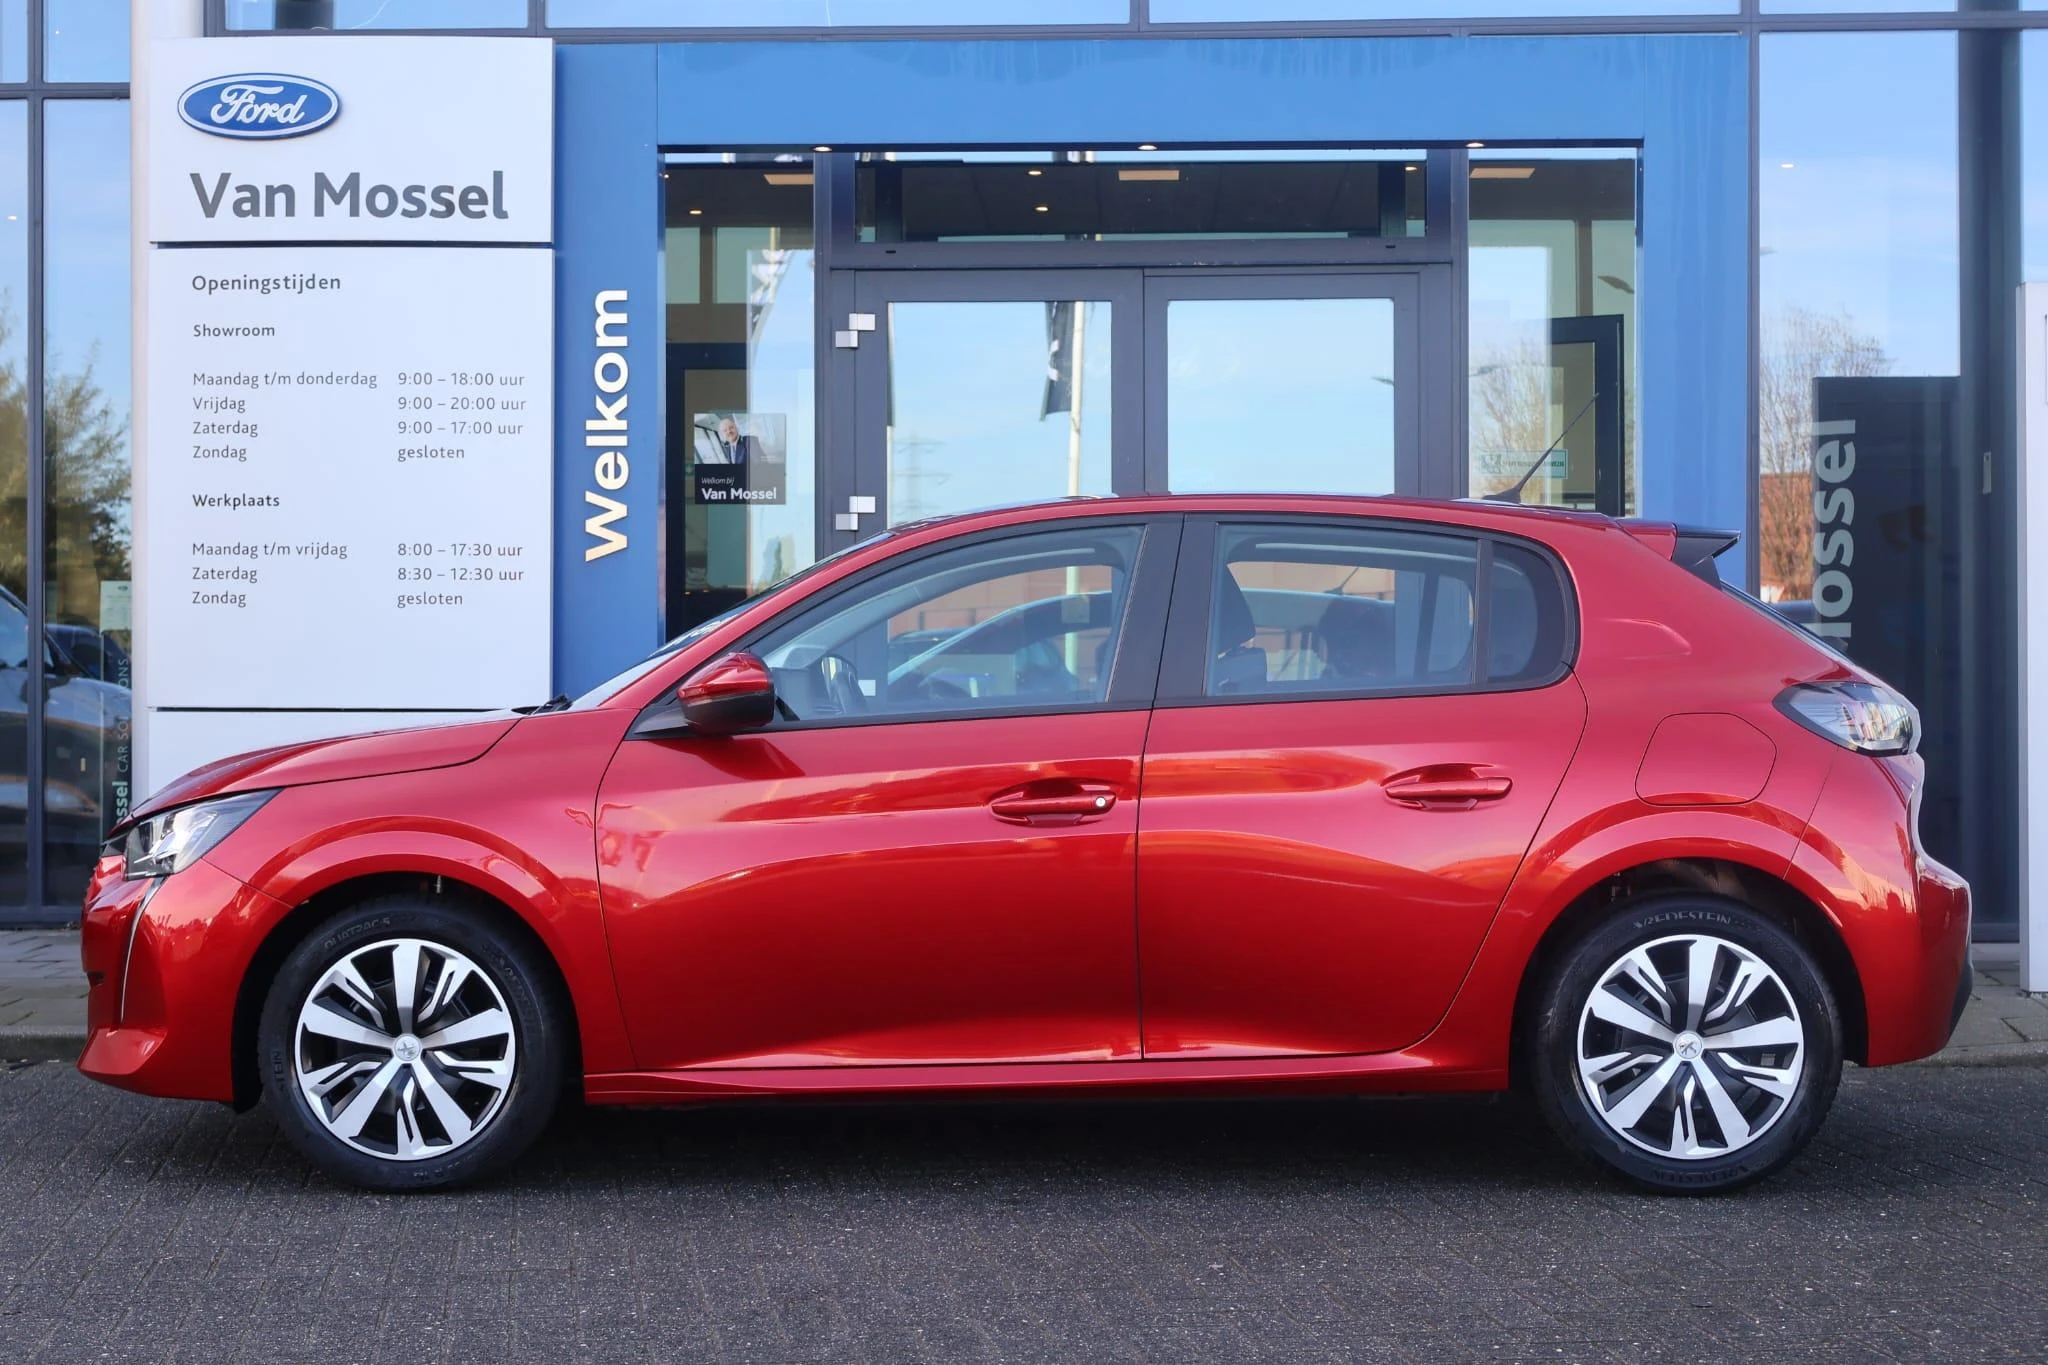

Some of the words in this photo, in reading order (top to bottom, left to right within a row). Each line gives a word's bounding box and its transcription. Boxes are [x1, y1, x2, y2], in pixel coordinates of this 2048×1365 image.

[211, 84, 307, 125] Ford
[189, 172, 296, 219] Van
[313, 170, 510, 220] Mossel
[191, 273, 341, 295] Openingstijden
[193, 323, 276, 338] Showroom
[193, 372, 260, 389] Maandag
[263, 372, 292, 387] t/m
[296, 372, 378, 389] donderdag
[397, 372, 433, 386] 9:00
[450, 372, 494, 386] 18:00
[499, 376, 525, 386] uur
[193, 396, 246, 415] Vrijdag
[397, 397, 433, 410] 9:00
[450, 397, 496, 410] 20:00
[501, 400, 527, 410] uur
[193, 420, 259, 438] Zaterdag
[397, 421, 433, 435] 9:00
[450, 421, 493, 435] 17:00
[497, 424, 524, 435] uur
[585, 290, 629, 562] Welkom
[193, 444, 248, 463] Zondag
[397, 445, 465, 462] gesloten
[192, 493, 280, 511] Werkplaats
[702, 488, 726, 500] Van
[731, 487, 777, 500] Mossel
[192, 542, 259, 560] Maandag
[263, 542, 291, 556] t/m
[296, 542, 348, 560] vrijdag
[397, 543, 433, 557] 8:00
[450, 543, 493, 557] 17:30
[497, 546, 523, 557] uur
[192, 566, 258, 584] Zaterdag
[397, 567, 433, 581] 8:30
[450, 567, 494, 581] 12:30
[498, 570, 525, 581] uur
[191, 590, 247, 609] Zondag
[397, 592, 463, 609] gesloten
[118, 745, 129, 773] CAR
